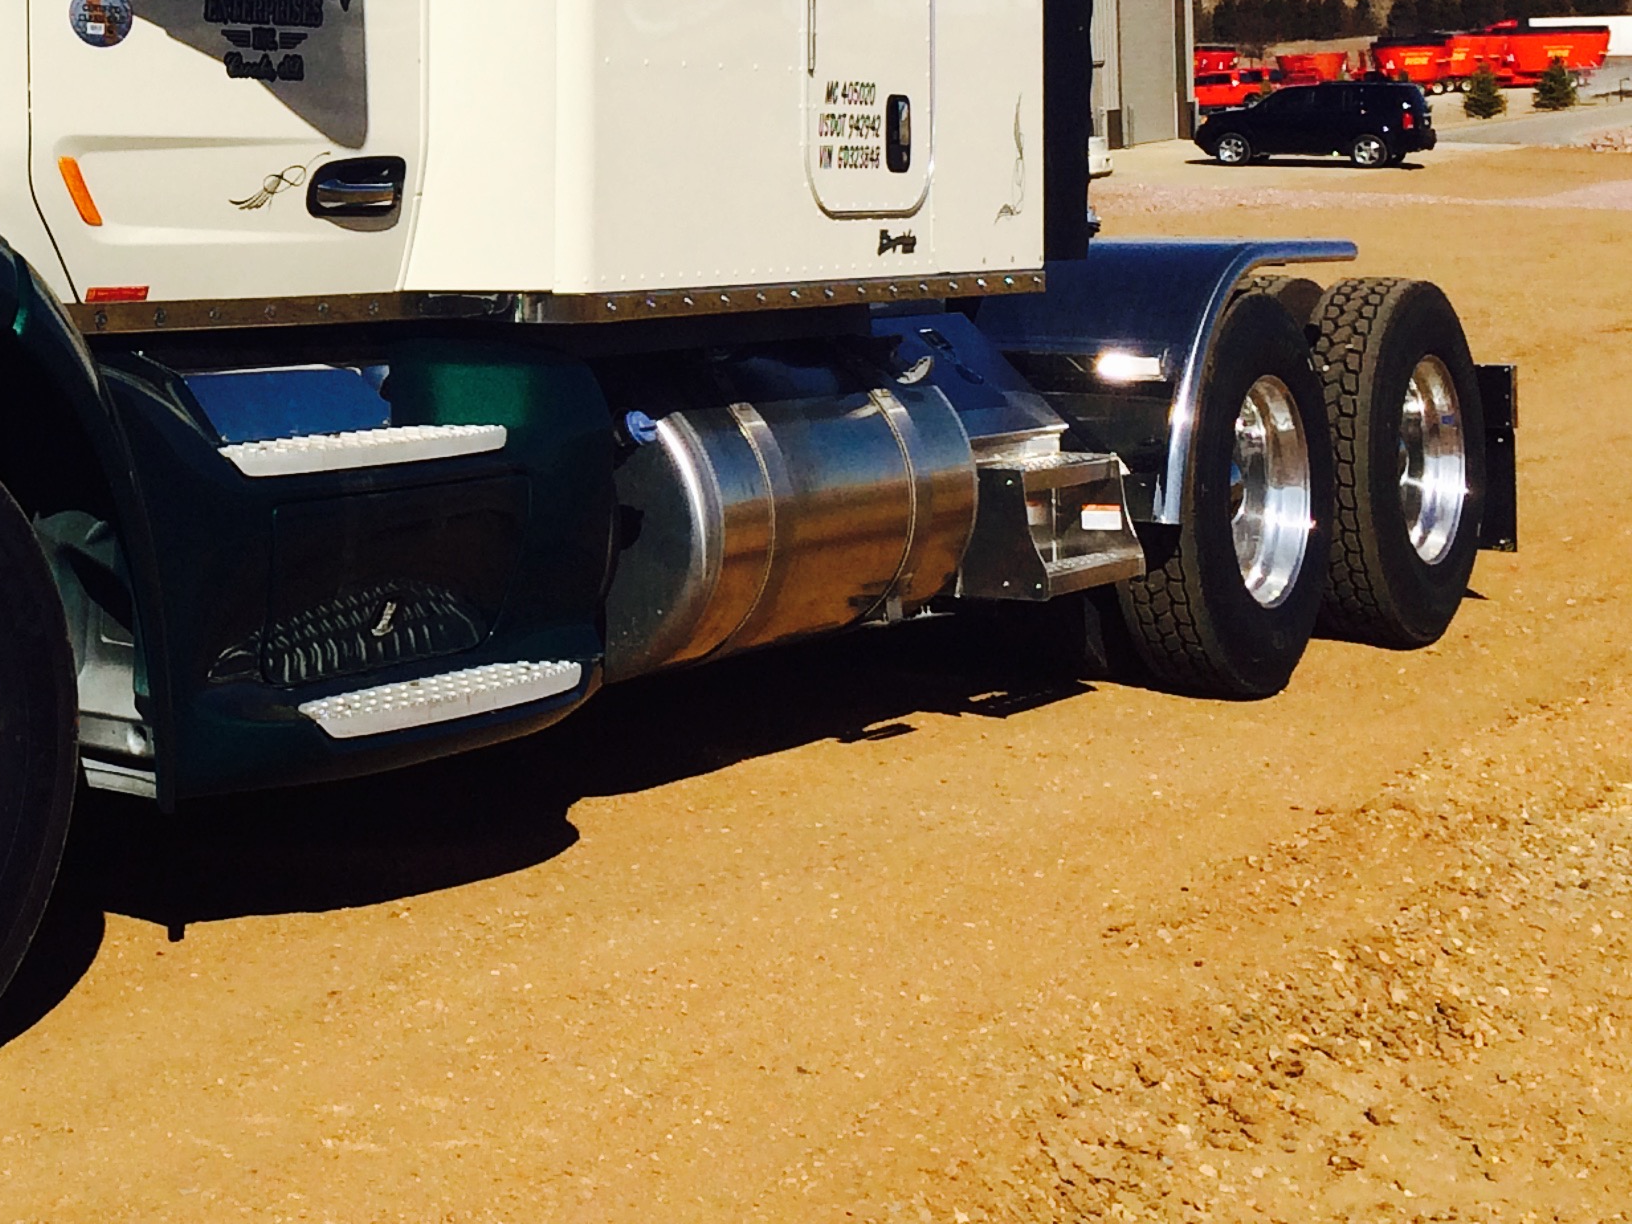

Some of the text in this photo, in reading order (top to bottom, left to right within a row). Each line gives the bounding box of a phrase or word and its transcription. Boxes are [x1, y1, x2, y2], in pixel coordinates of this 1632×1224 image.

[824, 80, 839, 105] MC
[818, 113, 847, 137] USDOT
[819, 145, 834, 169] VIN
